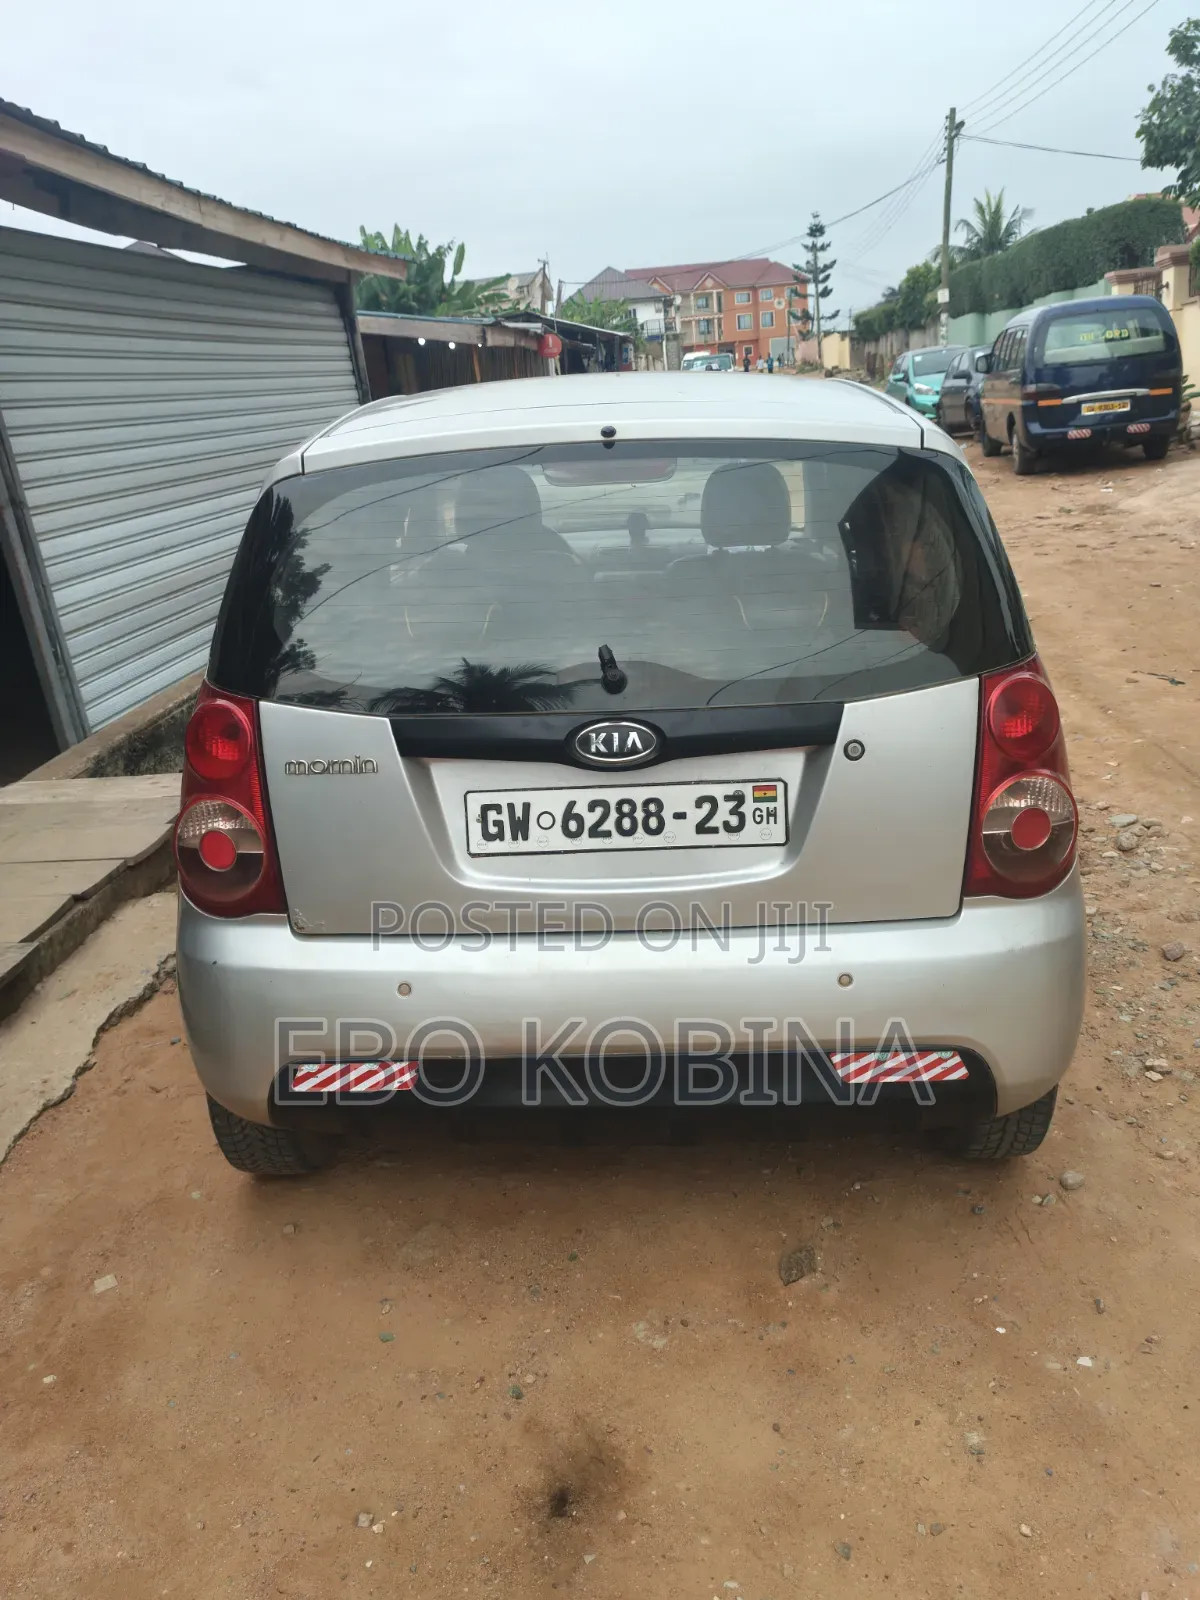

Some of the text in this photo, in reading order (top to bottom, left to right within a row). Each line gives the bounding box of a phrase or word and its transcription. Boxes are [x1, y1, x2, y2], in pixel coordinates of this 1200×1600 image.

[589, 732, 644, 754] KIA
[285, 753, 378, 775] mornin
[480, 801, 531, 842] GW
[752, 806, 777, 825] GH
